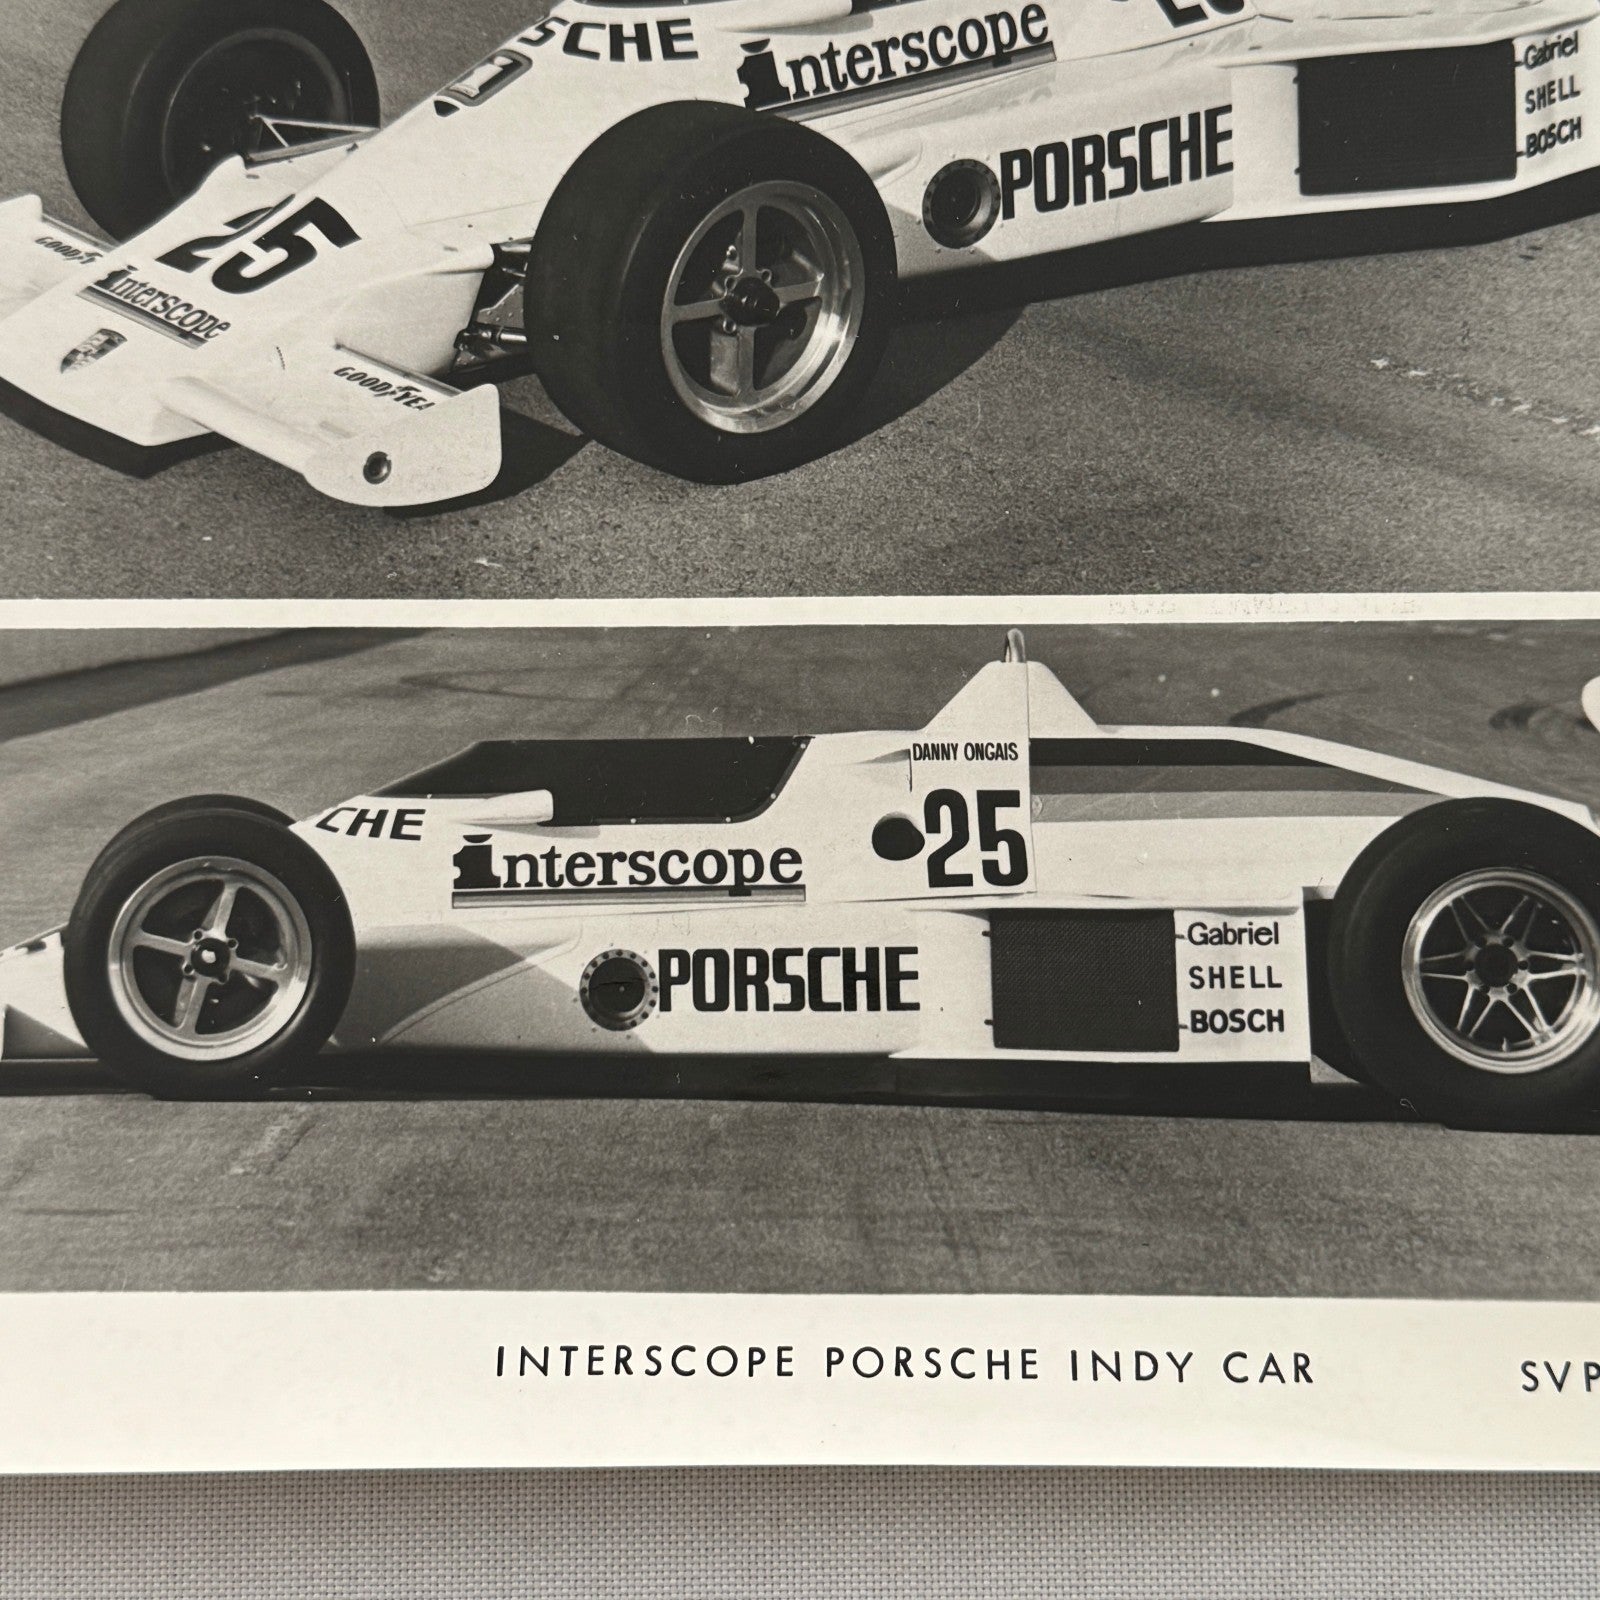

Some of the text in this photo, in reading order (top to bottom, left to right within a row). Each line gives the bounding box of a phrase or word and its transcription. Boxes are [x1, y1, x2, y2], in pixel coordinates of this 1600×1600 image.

[738, 3, 1049, 108] interscope
[1523, 30, 1579, 70] Gabriel
[1525, 75, 1581, 114] SHELL
[1525, 116, 1582, 158] BOSCH
[1000, 104, 1233, 220] PORSCHE
[155, 193, 361, 294] 25
[94, 264, 231, 339] interscope
[913, 742, 1019, 761] DANNY ONGAIS
[924, 788, 1028, 888] 25
[453, 834, 803, 896] interscope
[1187, 921, 1279, 946] Gabriel
[658, 946, 920, 1012] PORSCHE
[1189, 965, 1282, 989] SHELL
[1190, 1008, 1284, 1034] BOSCH
[496, 1344, 1314, 1384] INTERSCOPE PORSCHE INDY CAR
[1520, 1360, 1600, 1392] SVP
